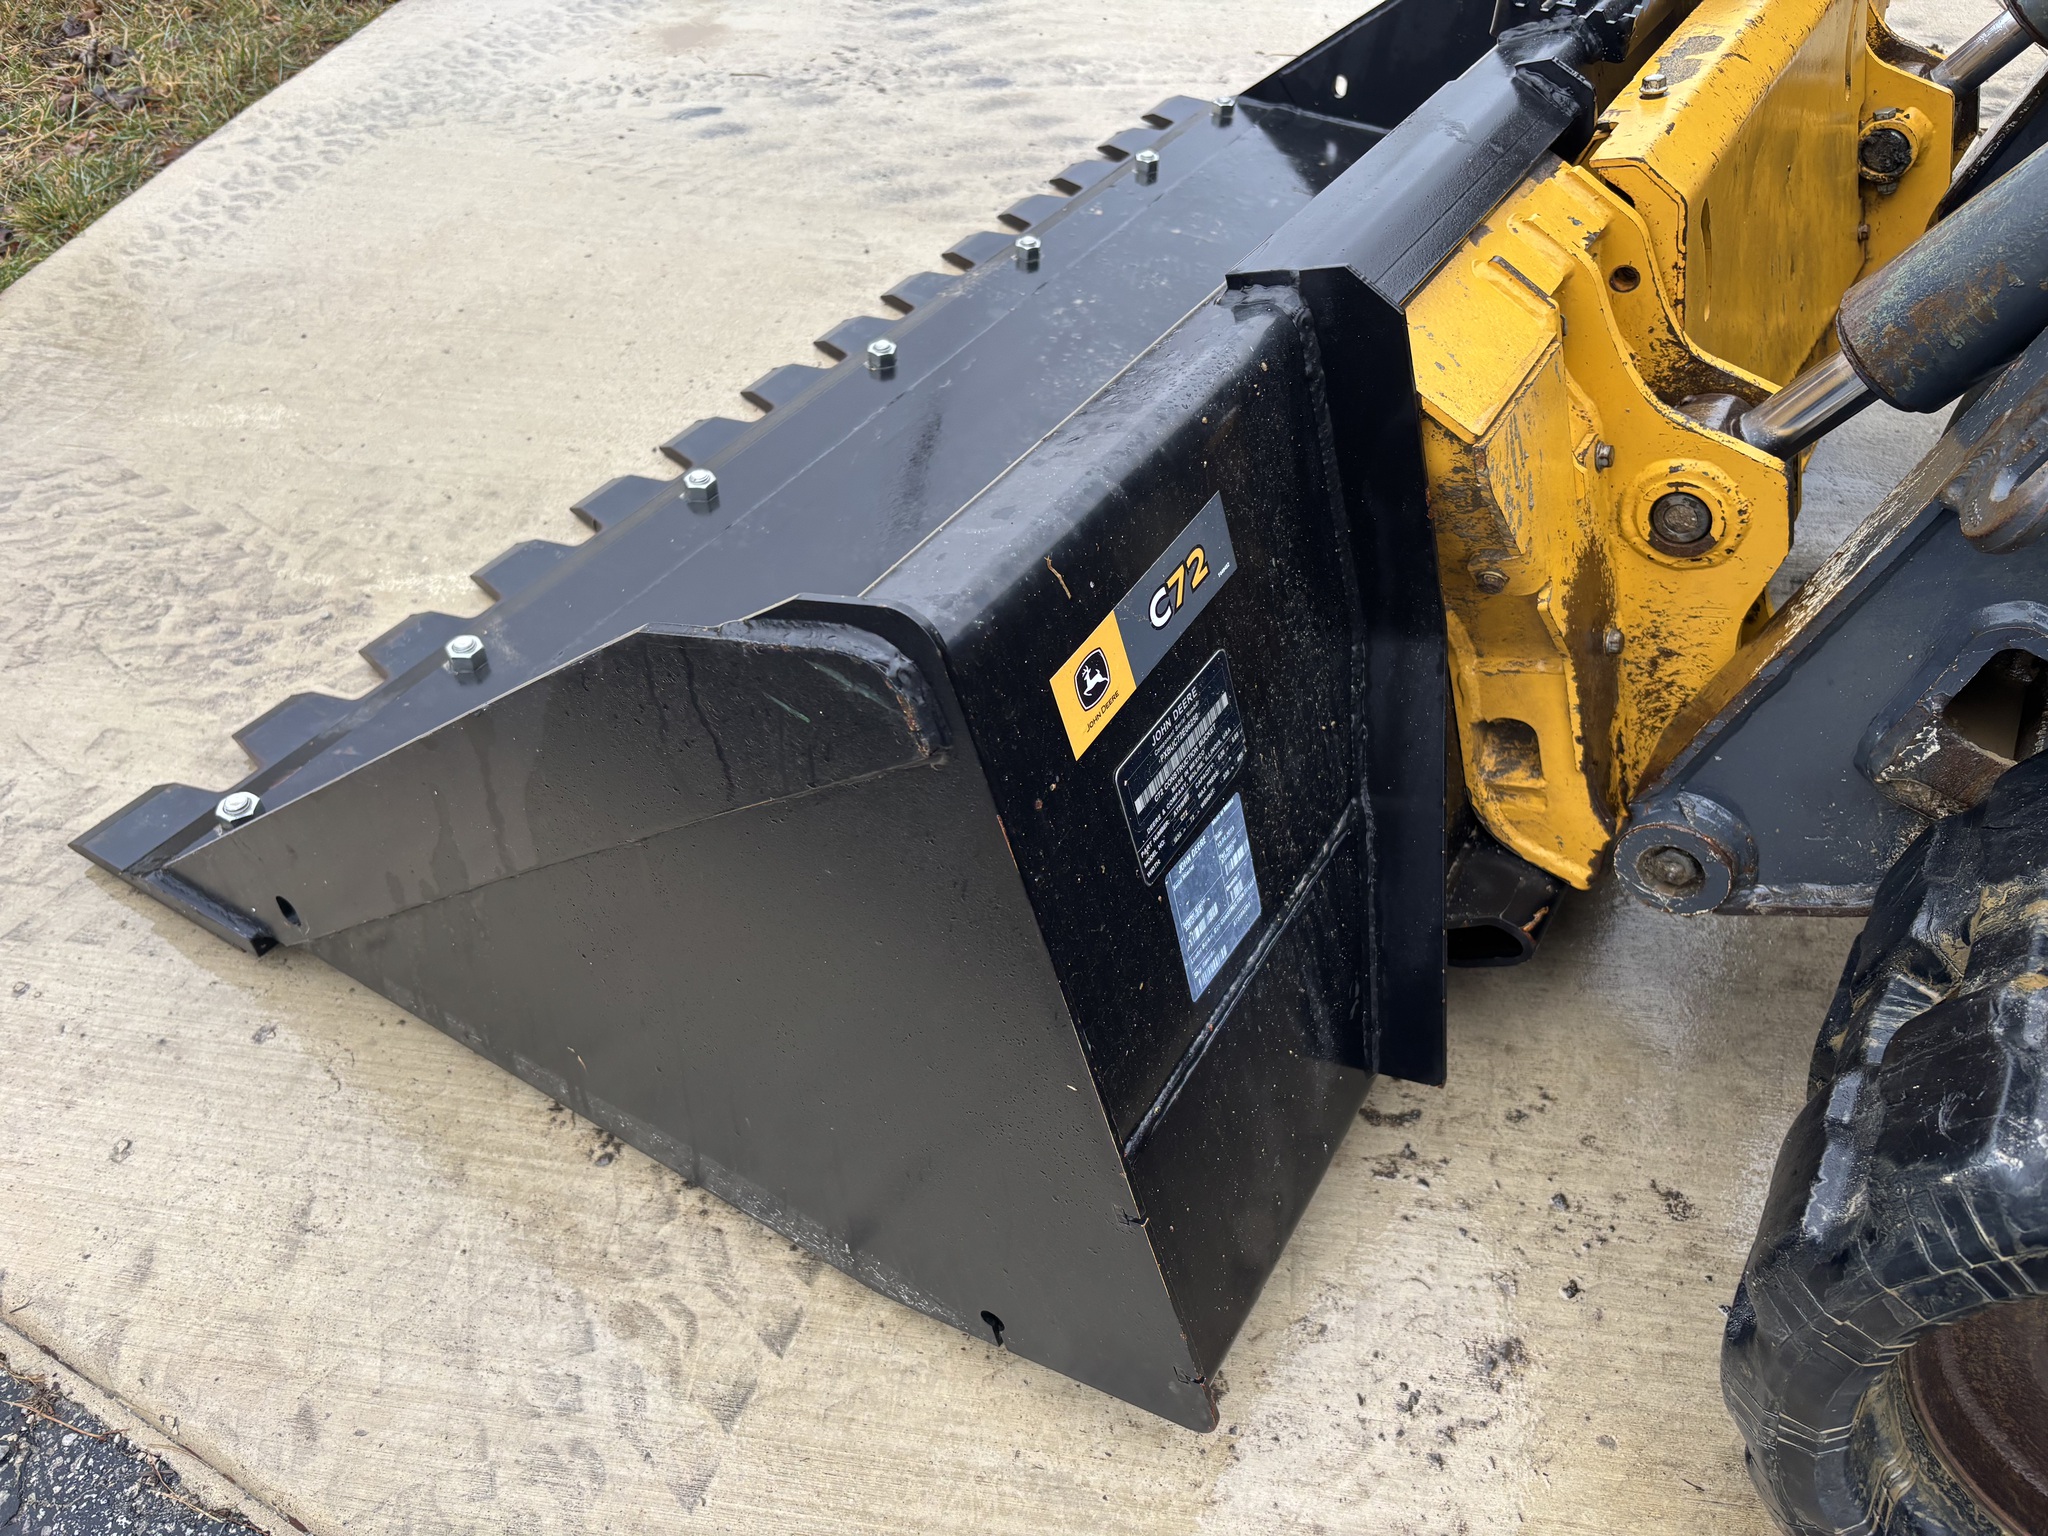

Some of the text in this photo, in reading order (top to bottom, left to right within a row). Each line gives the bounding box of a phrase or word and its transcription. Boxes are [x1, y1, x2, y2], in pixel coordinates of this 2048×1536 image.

[1149, 545, 1209, 629] C72
[1086, 689, 1119, 732] JOHN DEERE
[1151, 686, 1197, 747] JOHN DEERE
[1154, 699, 1200, 756] Component Serial Number
[1147, 814, 1161, 834] DEERE
[1161, 807, 1165, 816] &
[1222, 726, 1231, 739] USA
[1154, 788, 1164, 802] C72
[1164, 745, 1198, 790] CONSTRUCTION
[1199, 723, 1216, 747] BUCKET
[1171, 775, 1184, 792] MADE
[1183, 767, 1188, 778] IN
[1189, 749, 1204, 770] MEXICO
[1197, 786, 1206, 799] MAX
[1140, 841, 1153, 857] PART
[1144, 847, 1158, 867] MODEL
[1178, 835, 1206, 873] JOHN DEERE
